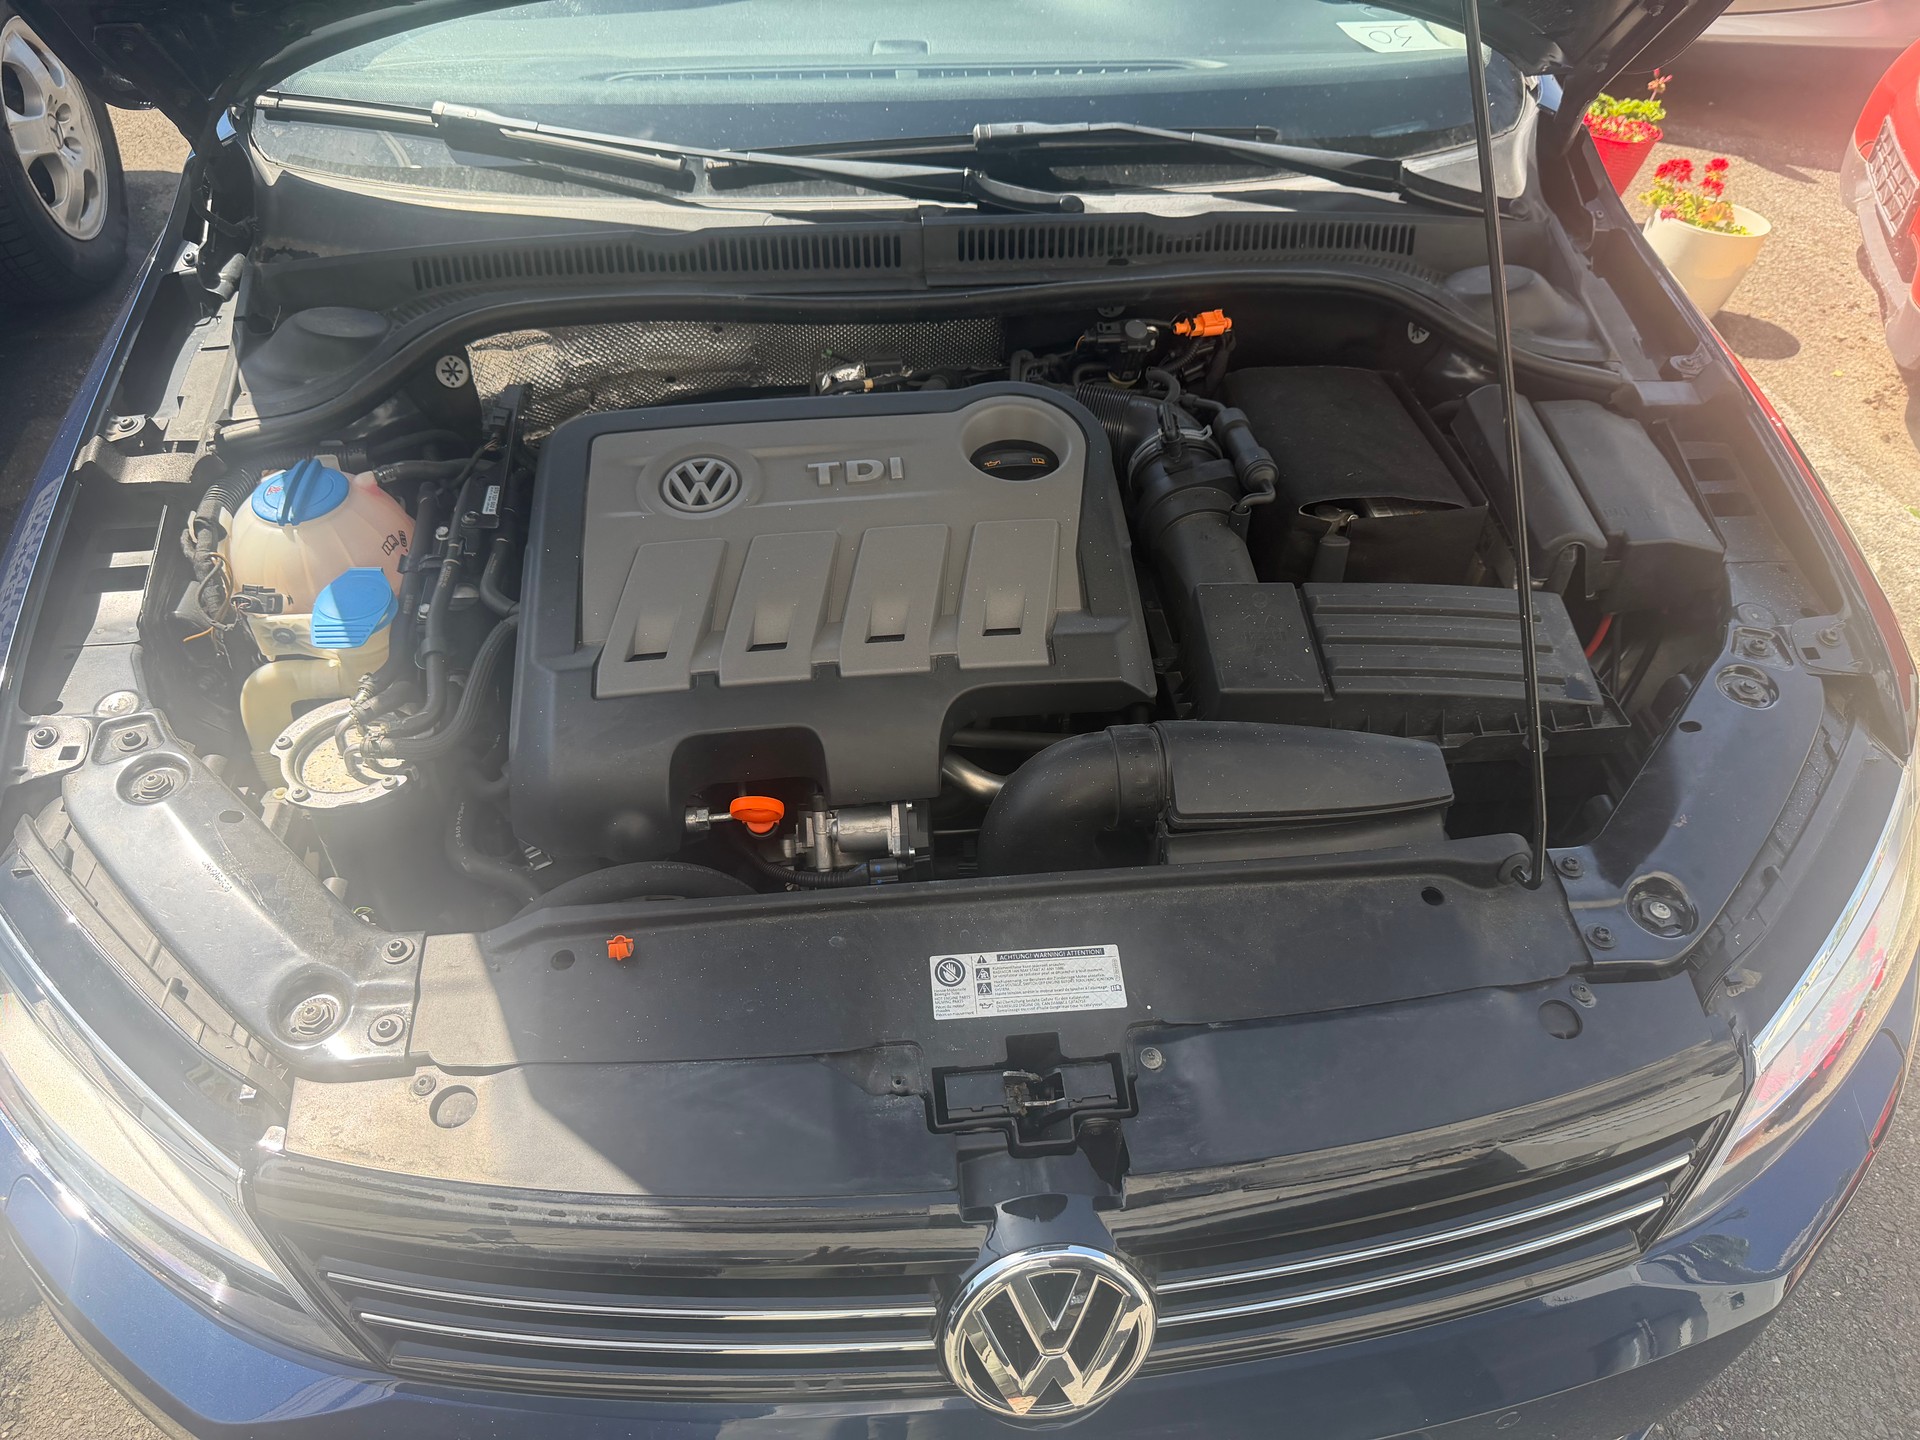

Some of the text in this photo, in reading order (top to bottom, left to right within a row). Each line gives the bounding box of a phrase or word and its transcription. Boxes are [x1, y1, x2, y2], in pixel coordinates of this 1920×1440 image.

[663, 457, 740, 512] VW
[807, 456, 904, 486] TDI
[1033, 950, 1065, 958] WARNING!
[1066, 948, 1102, 956] ATTENTION!
[947, 1246, 1155, 1418] VW
